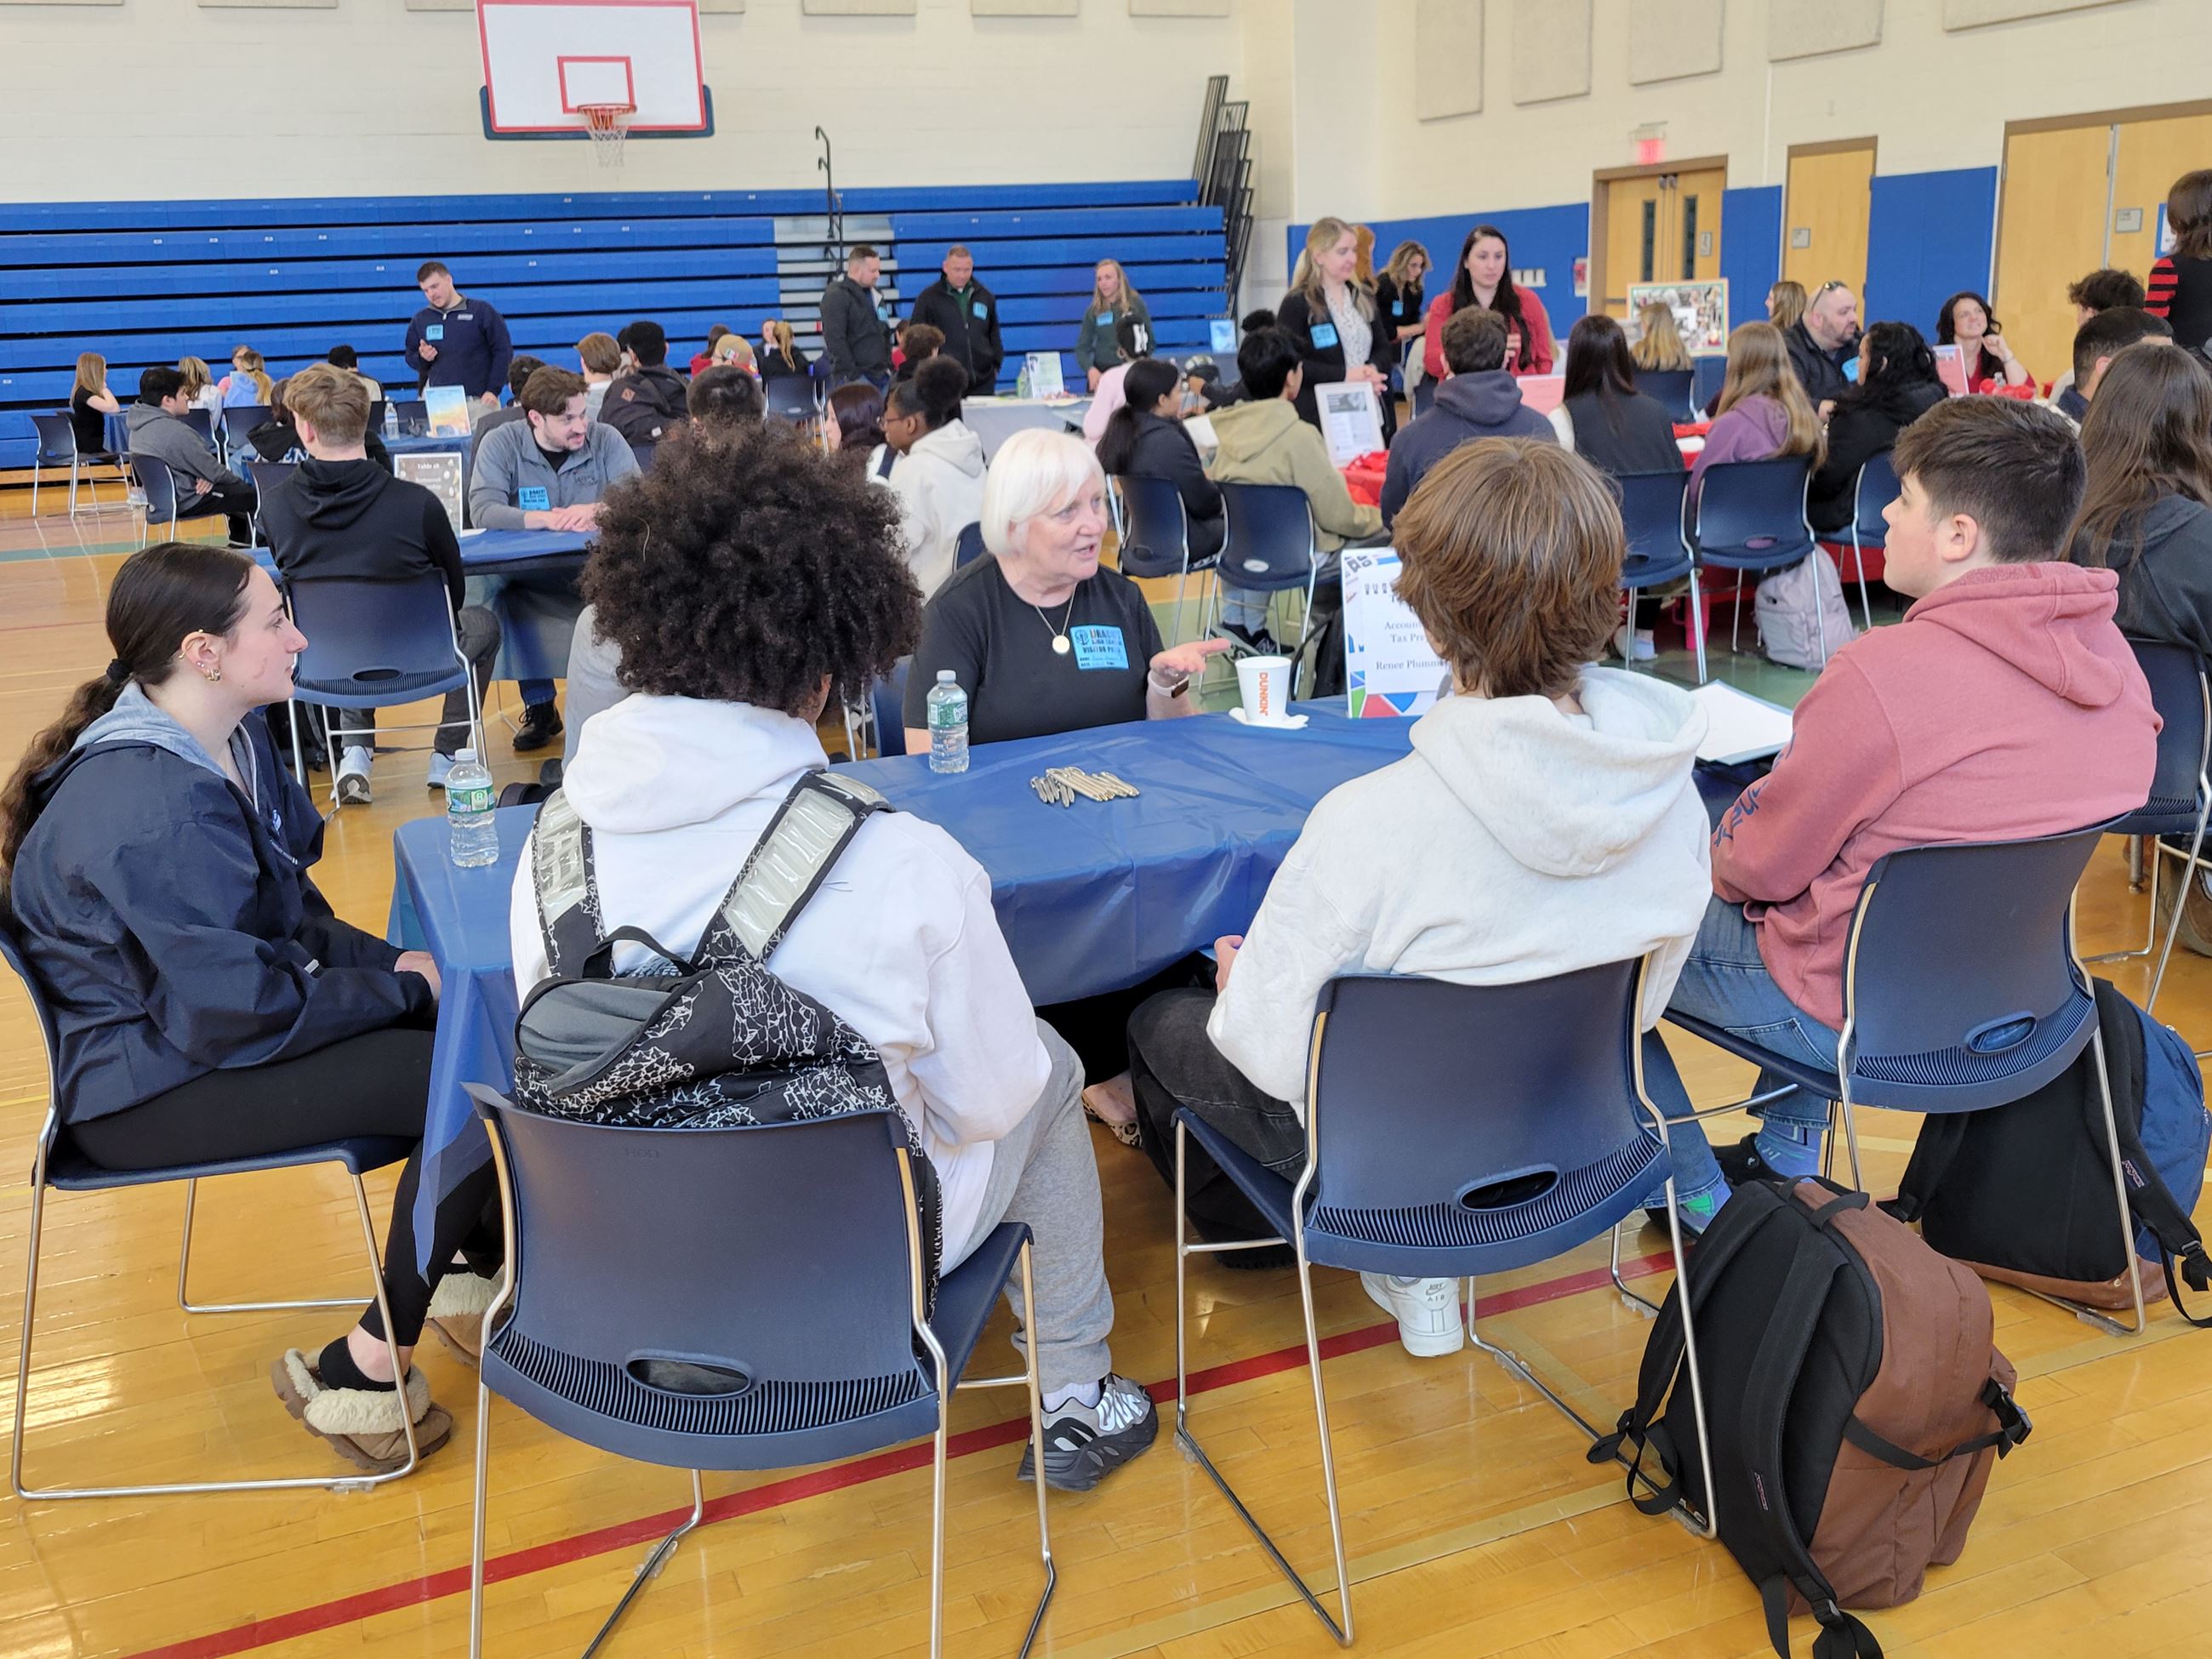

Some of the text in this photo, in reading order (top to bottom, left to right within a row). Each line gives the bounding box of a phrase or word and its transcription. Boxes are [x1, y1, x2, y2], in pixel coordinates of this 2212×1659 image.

[1389, 632, 1425, 643] Tax Pre
[1376, 661, 1405, 670] Renee
